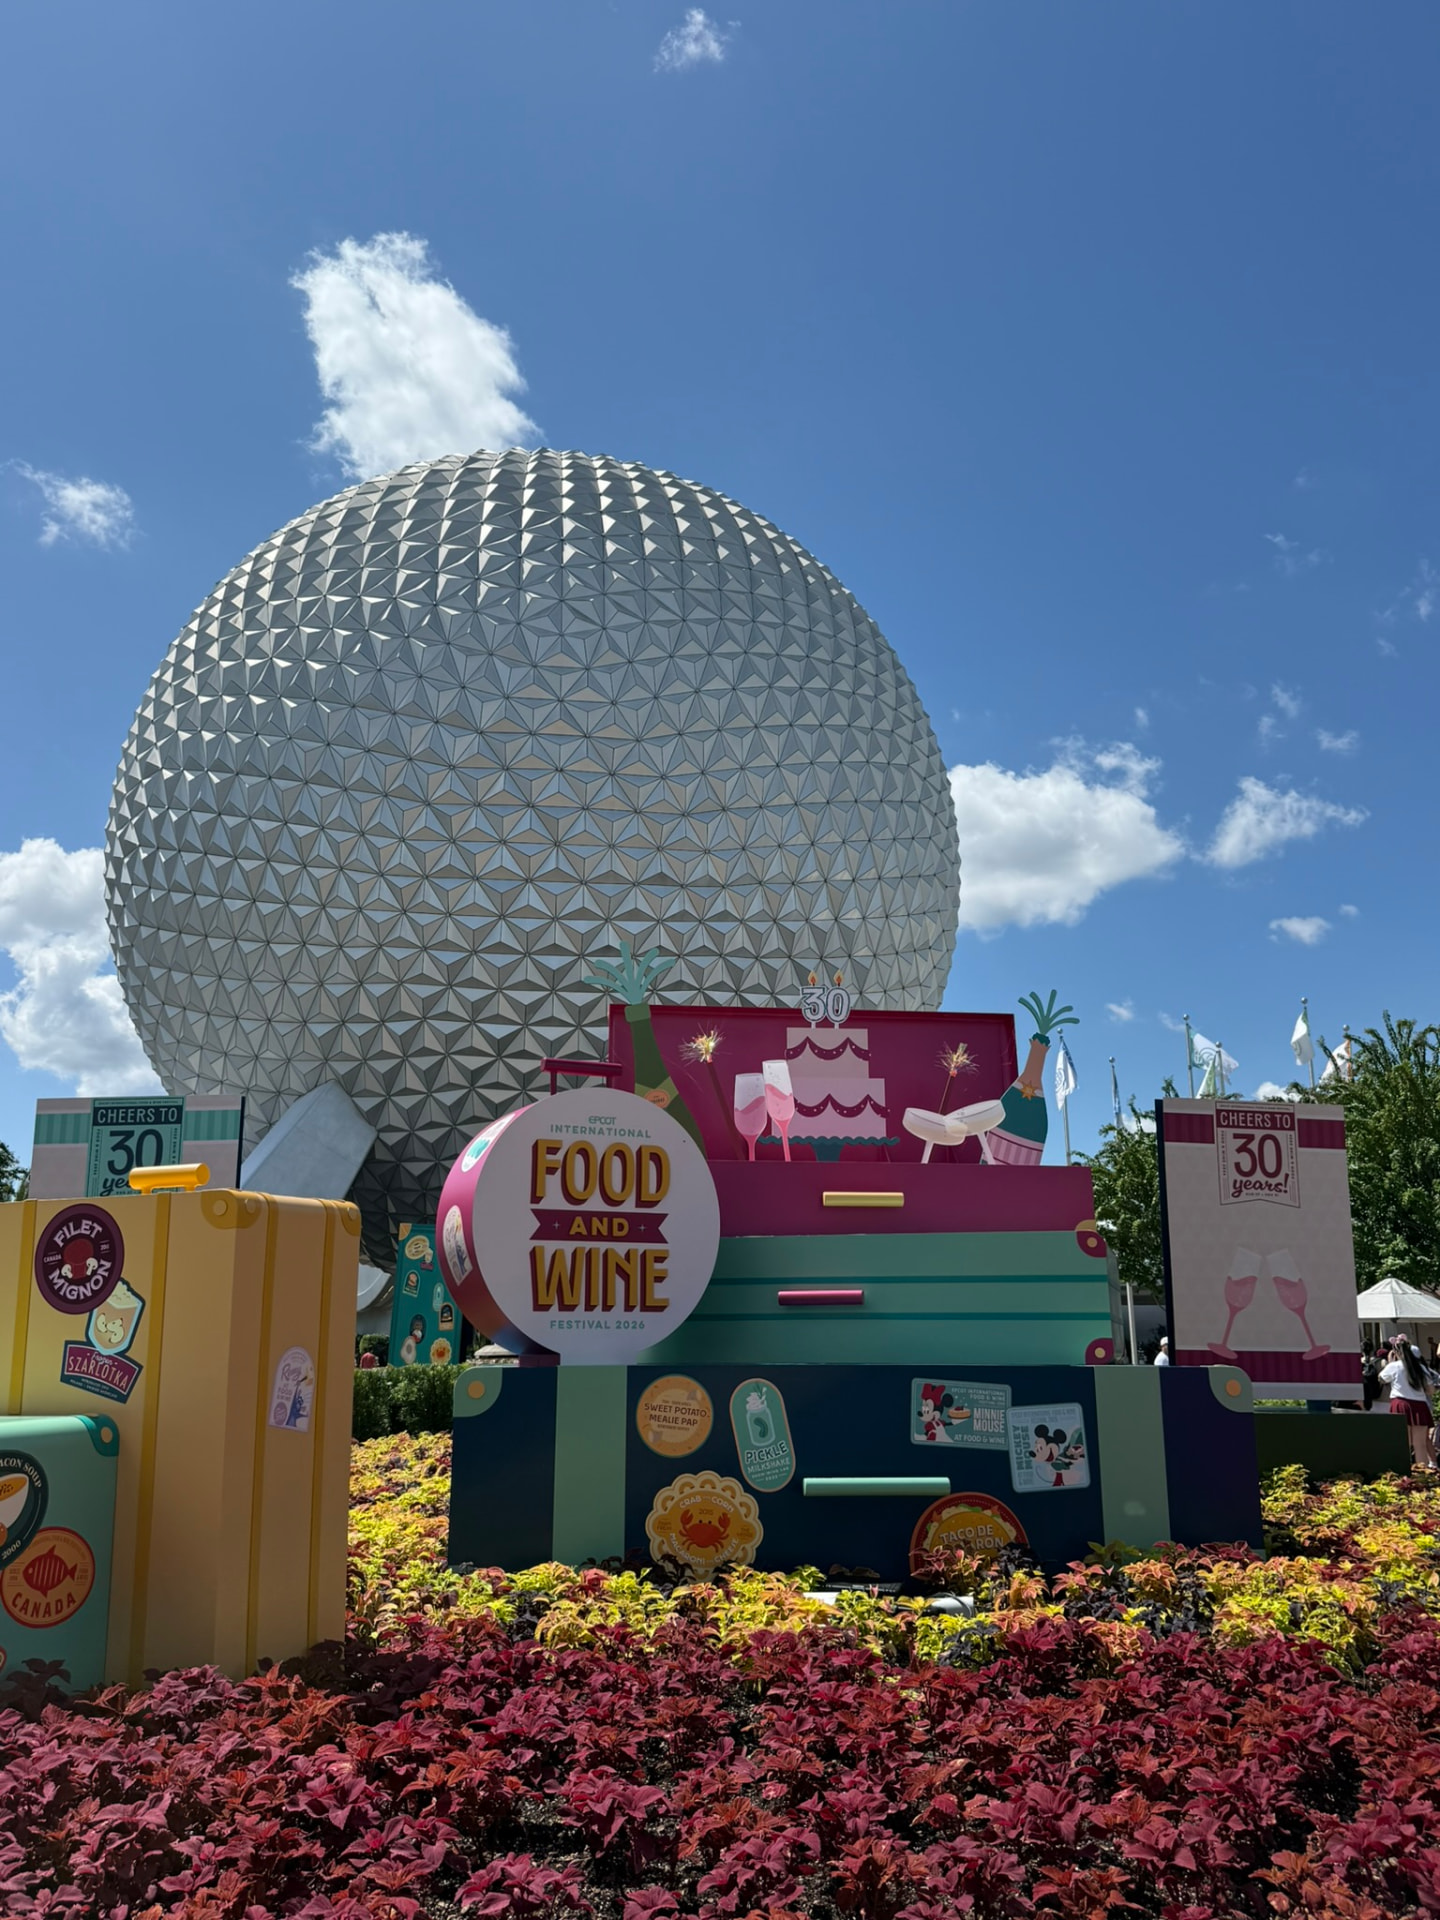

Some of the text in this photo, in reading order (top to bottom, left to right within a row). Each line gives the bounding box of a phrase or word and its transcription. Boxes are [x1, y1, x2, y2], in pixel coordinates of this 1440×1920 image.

[800, 986, 851, 1024] 30
[97, 1107, 178, 1123] CHEERS TO
[588, 1115, 617, 1125] EPCOT
[1220, 1111, 1291, 1129] CHEERS TO
[550, 1124, 651, 1138] INTERNATIONAL
[107, 1128, 164, 1176] 30
[1232, 1132, 1283, 1179] 30
[530, 1138, 671, 1209] FOOD
[1231, 1172, 1289, 1198] years!
[53, 1219, 103, 1247] FILET
[569, 1216, 630, 1237] AND
[48, 1259, 112, 1300] MIGNON
[529, 1245, 670, 1312] WINE
[550, 1320, 645, 1330] FESTIVAL 2026
[643, 1403, 673, 1414] SWEET
[972, 1408, 1005, 1420] MINNIE
[648, 1414, 699, 1427] MEALIE PAP
[972, 1419, 1005, 1433] MOUSE
[963, 1434, 982, 1442] FOOD
[1011, 1425, 1025, 1470] MICKEY
[1021, 1425, 1033, 1470] MOUSE
[745, 1440, 789, 1465] PICKLE
[0, 1458, 42, 1488] ACON SOUP
[747, 1458, 791, 1475] MILKSHAKE
[680, 1495, 734, 1513] CRAB CORN
[940, 1524, 994, 1545] TACO DE
[1, 1540, 23, 1560] 2000
[670, 1533, 705, 1565] MACARONI
[12, 1592, 77, 1618] CANADA
